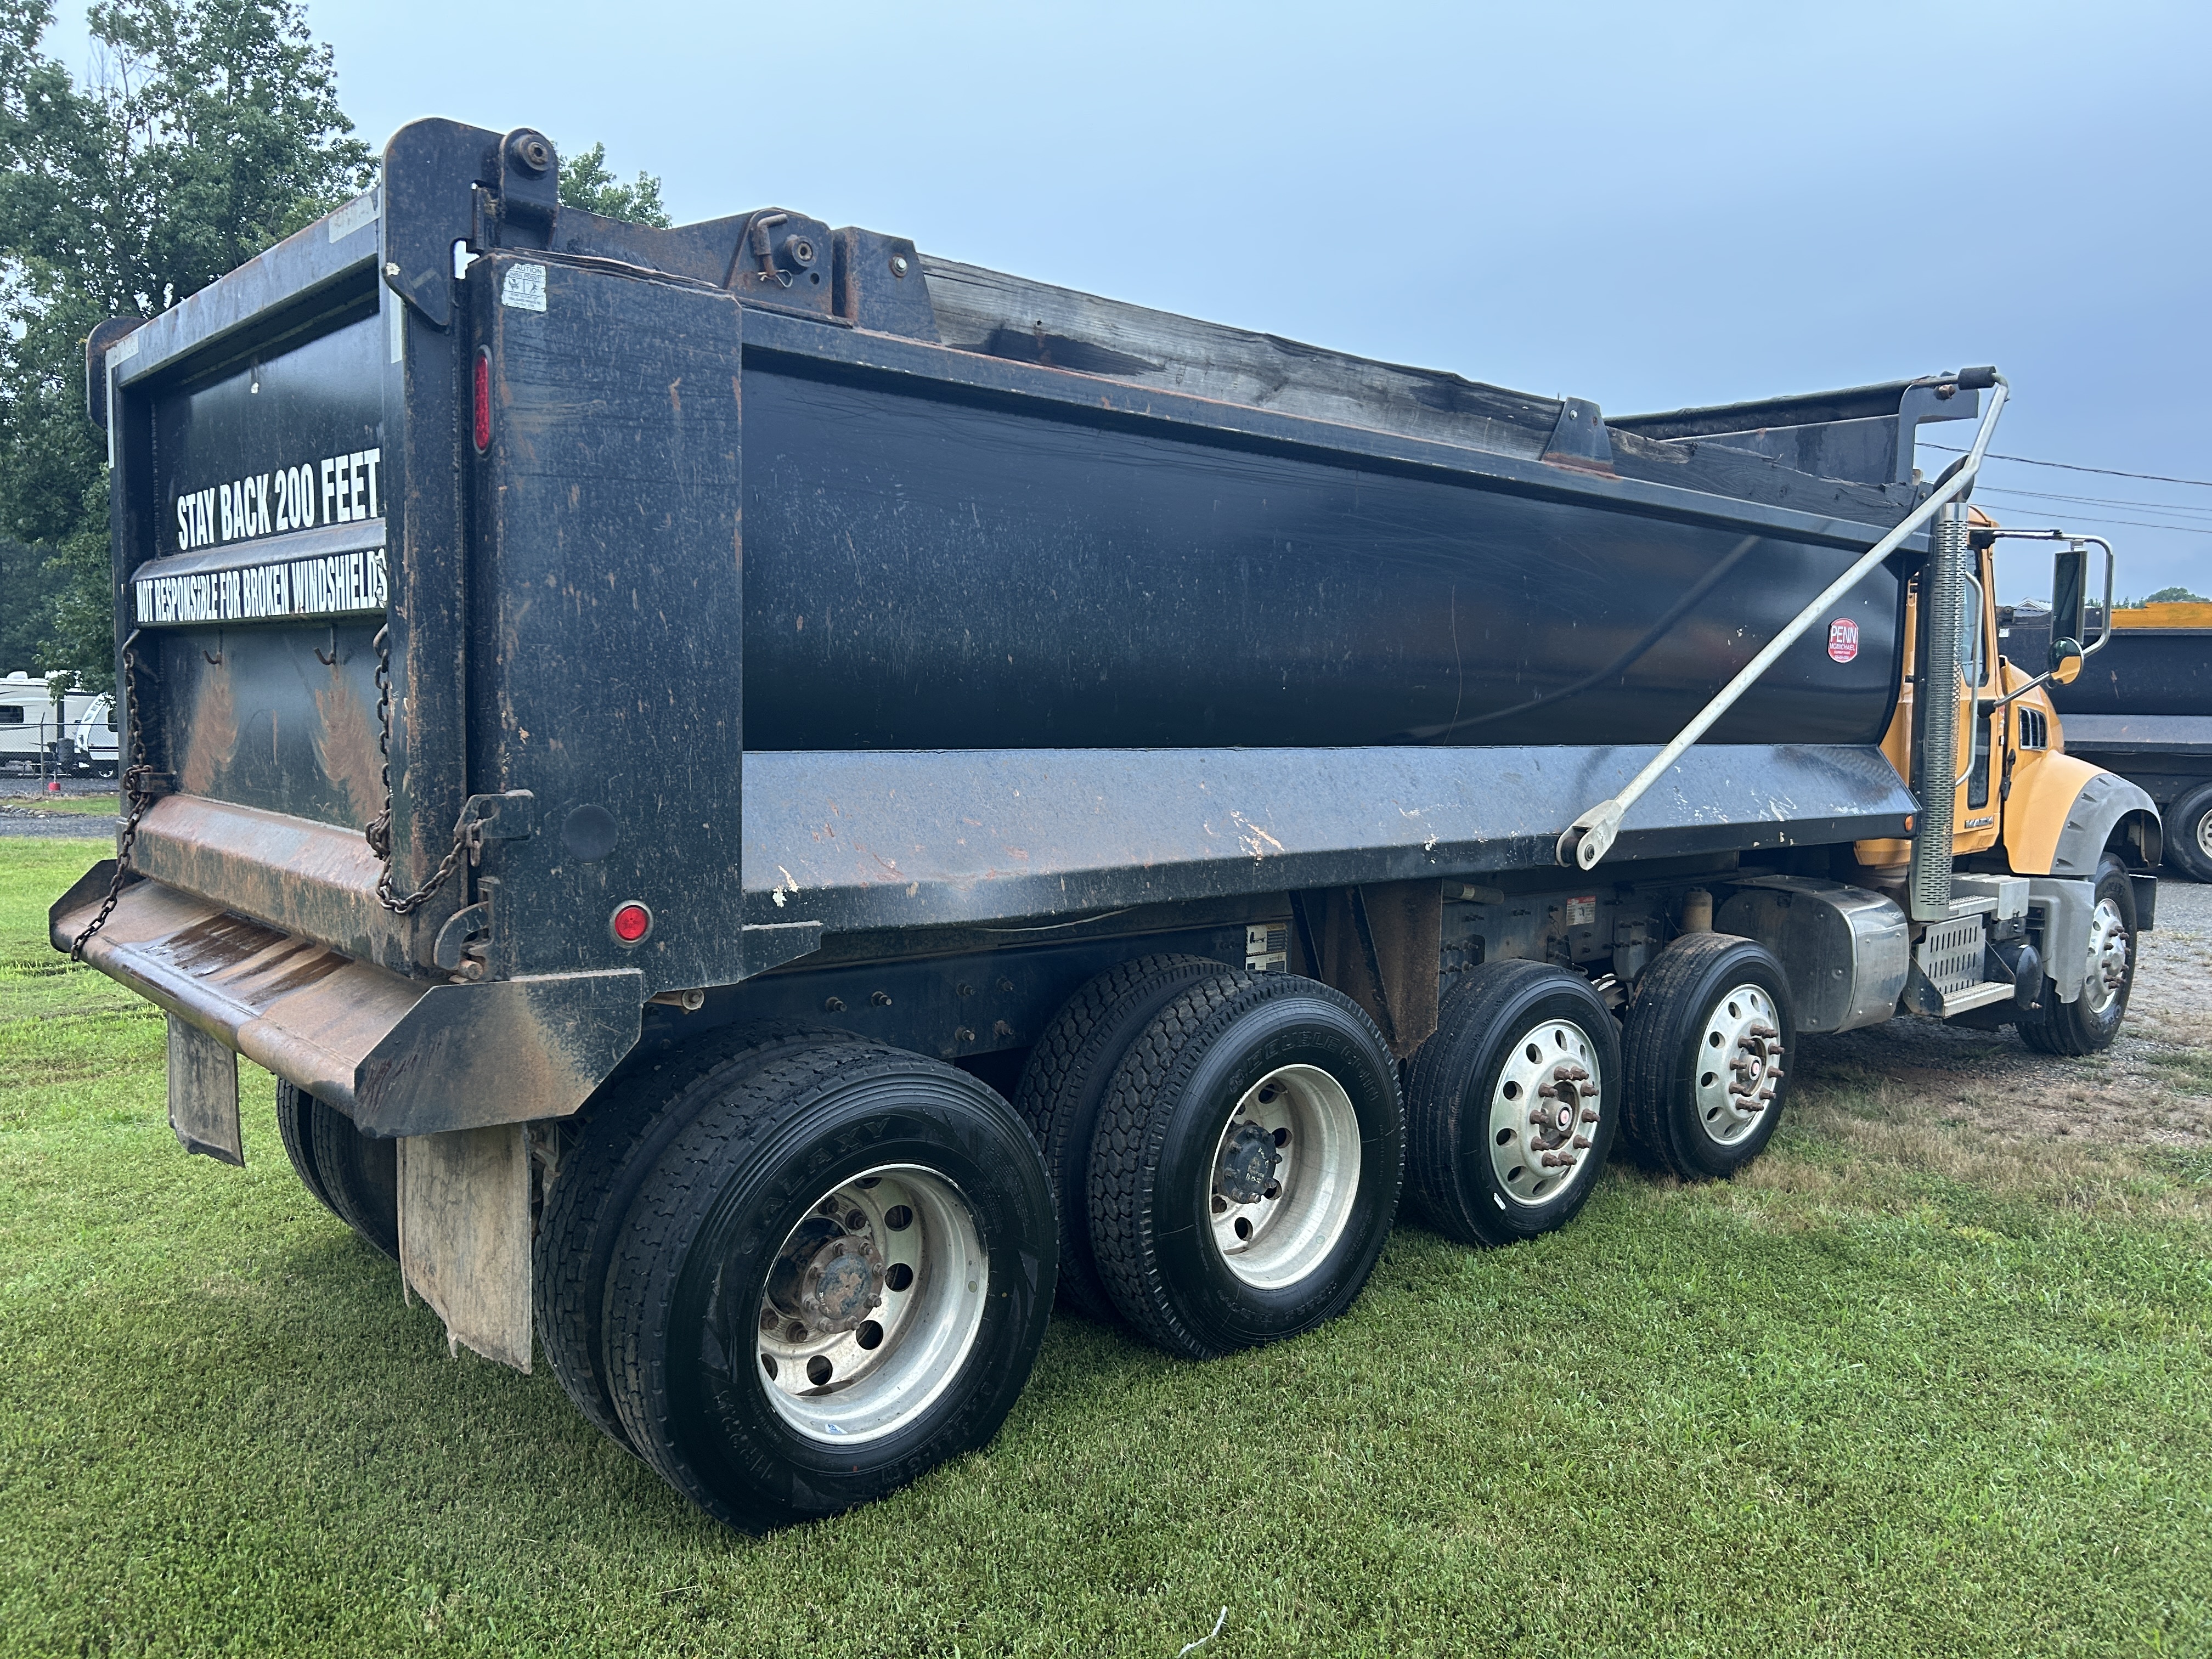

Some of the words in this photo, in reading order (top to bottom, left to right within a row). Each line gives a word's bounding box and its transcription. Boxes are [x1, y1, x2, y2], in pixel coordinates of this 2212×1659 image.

[177, 488, 215, 550] STAY
[219, 473, 271, 541] BACK
[274, 463, 315, 531] 200
[321, 448, 381, 524] FEET
[136, 580, 154, 622] NOT
[154, 574, 218, 622] RESPONSIBLE
[219, 571, 241, 619] FOR
[242, 563, 290, 618] BROKEN
[291, 548, 388, 614] WINDSHIELDS
[1830, 625, 1857, 644] PENN
[740, 1116, 891, 1255] GALAXY
